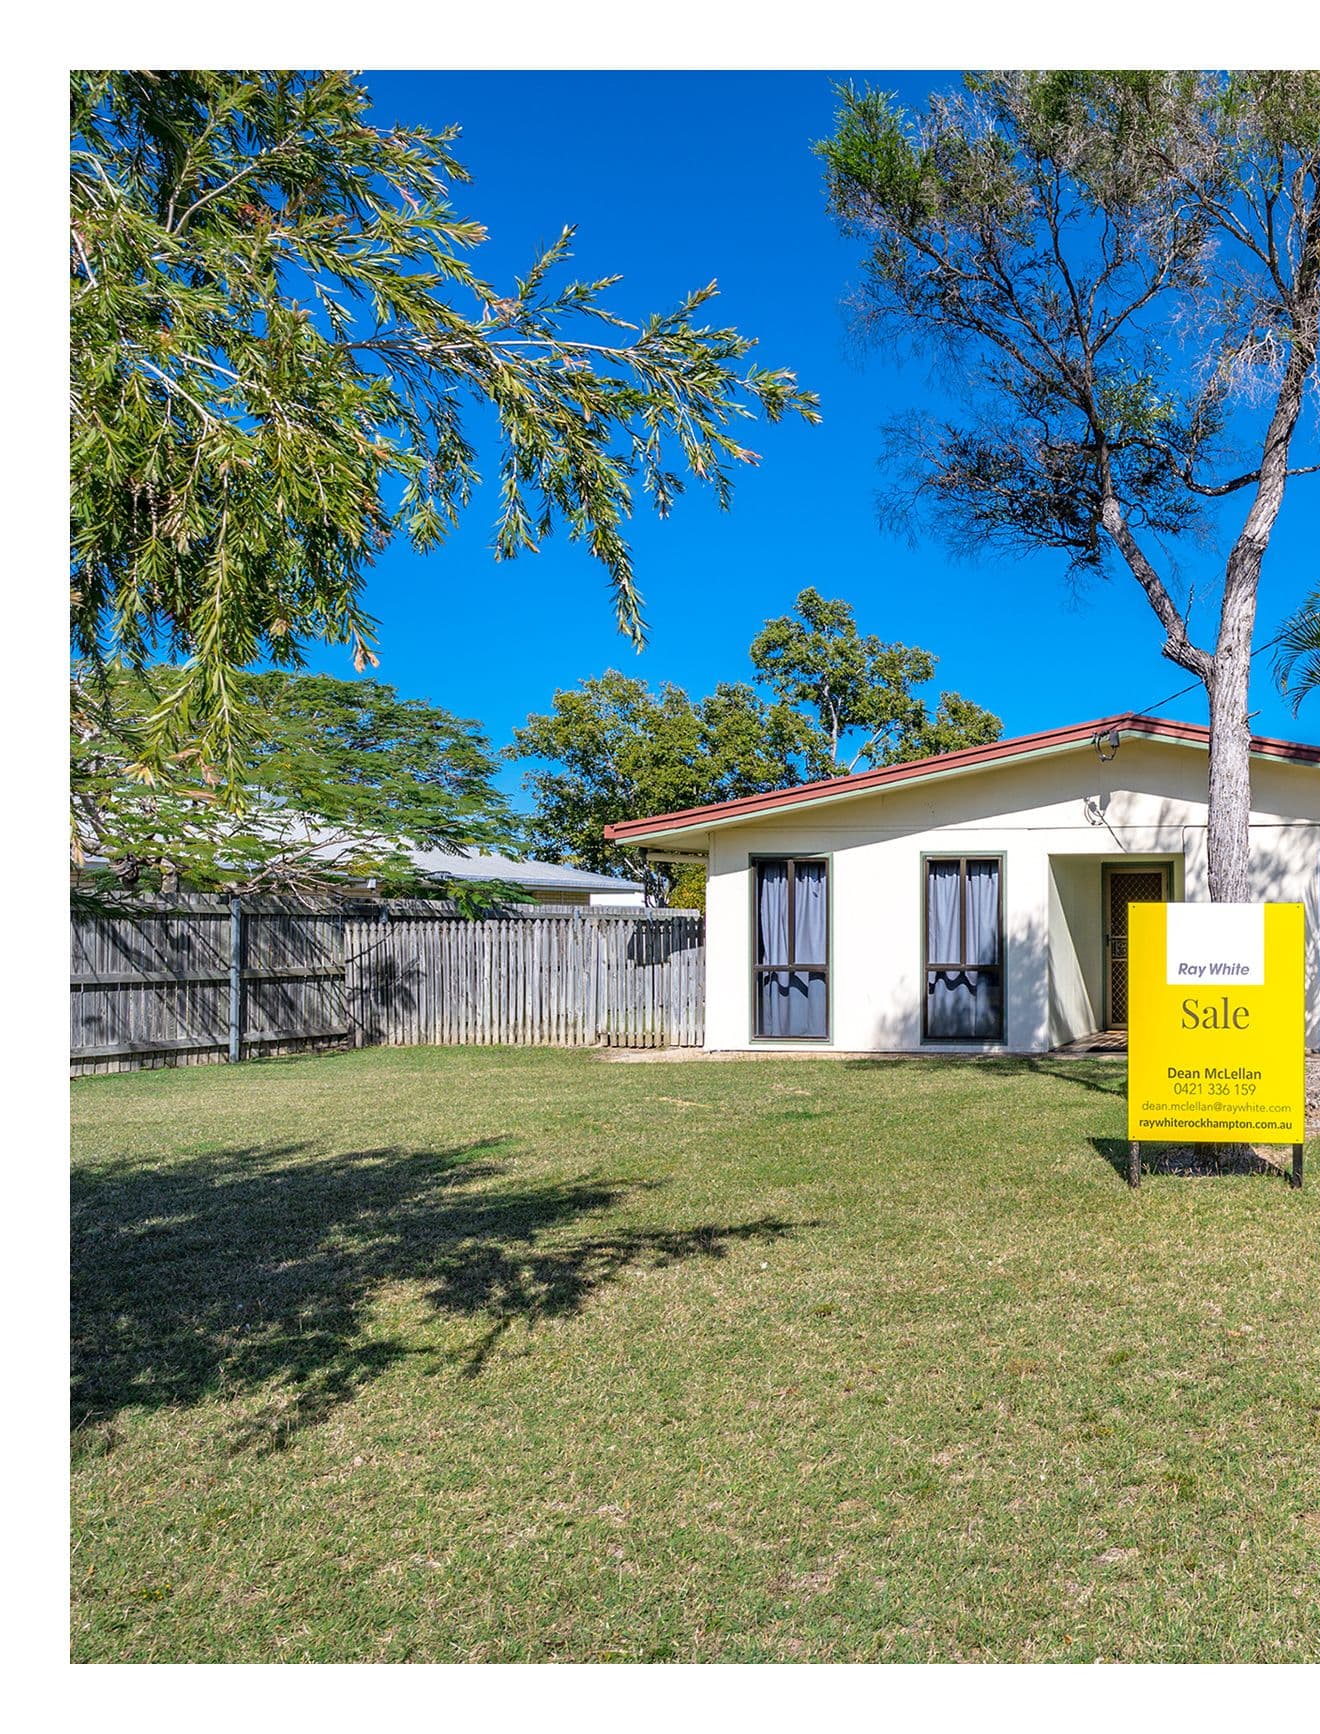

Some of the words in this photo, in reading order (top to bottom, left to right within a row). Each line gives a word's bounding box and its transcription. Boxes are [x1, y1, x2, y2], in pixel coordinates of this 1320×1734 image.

[1178, 962, 1206, 978] Ray
[1209, 963, 1250, 976] White
[1181, 997, 1251, 1030] Sale
[1167, 1067, 1200, 1079] Dean
[1205, 1067, 1262, 1080] McLellan
[1173, 1083, 1203, 1095] 0421
[1207, 1083, 1230, 1096] 336
[1234, 1083, 1256, 1096] 159
[1141, 1101, 1292, 1114] dean.mclellan@raywhite.com
[1139, 1117, 1293, 1131] raywhiterockhampton.com.au
